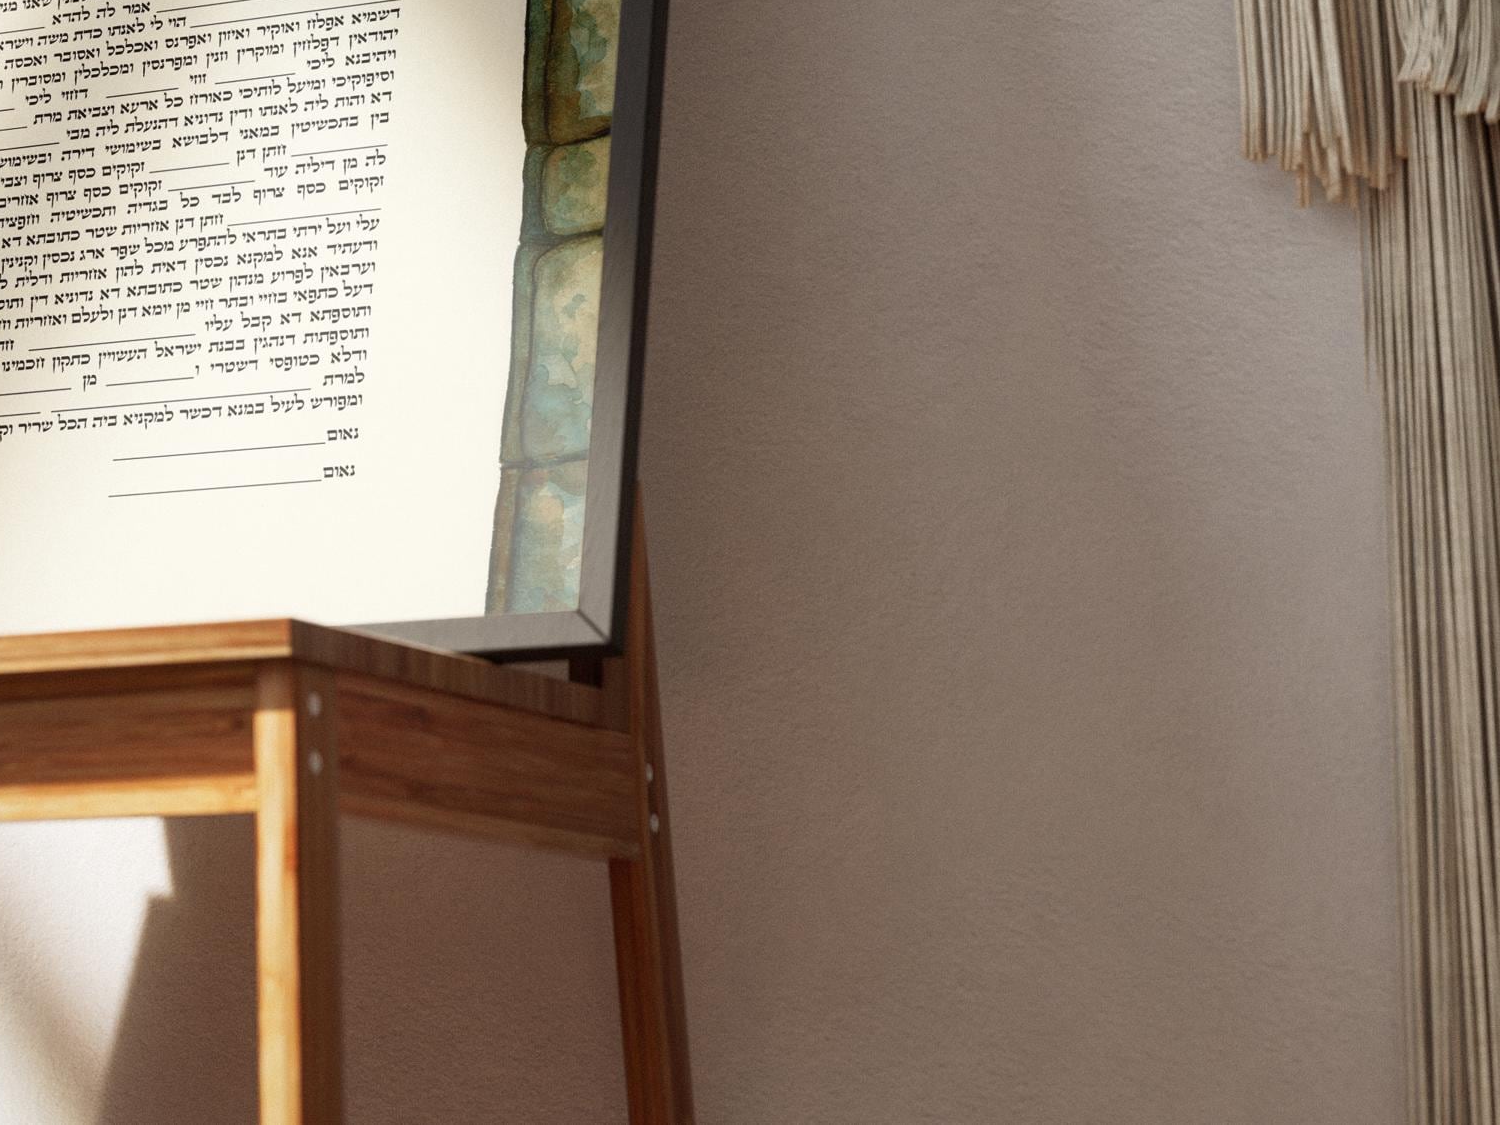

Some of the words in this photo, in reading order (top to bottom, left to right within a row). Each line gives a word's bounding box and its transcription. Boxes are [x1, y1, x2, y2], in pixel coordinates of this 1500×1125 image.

[107, 16, 146, 37] לאנתו
[149, 14, 164, 31] לי
[167, 16, 187, 28] הוי
[36, 32, 69, 47] משה
[72, 27, 103, 42] כדת
[348, 27, 399, 51] יהודאין
[236, 43, 285, 66] ומוקרין
[292, 32, 340, 58] דפלחין
[141, 54, 198, 78] ומפרנסין
[205, 50, 229, 70] וזנין
[306, 51, 336, 71] ליכי
[344, 48, 397, 67] ויהיבנא
[11, 71, 67, 94] ומסוברין
[73, 60, 135, 86] ומכלכלין
[189, 73, 207, 85] זוזי
[331, 69, 395, 92] וסיפוקיכי
[238, 78, 282, 100] לותיכי
[286, 76, 326, 94] ומיעל
[24, 87, 52, 107] ליכי
[60, 88, 89, 102] דחזי
[163, 91, 184, 109] כל
[189, 90, 233, 106] כאורח
[66, 104, 116, 121] וצביאת
[119, 98, 159, 115] ארעא
[32, 111, 63, 126] מרת
[290, 115, 359, 139] בתכשיטין
[370, 111, 390, 131] בין
[171, 126, 229, 149] דלבושא
[239, 124, 280, 140] במאני
[60, 146, 96, 162] דירה
[104, 138, 162, 156] בשימושי
[294, 155, 336, 175] דיליה
[342, 157, 358, 175] מן
[364, 148, 387, 167] לה
[263, 165, 289, 179] עוד
[45, 189, 77, 209] צרוף
[83, 185, 112, 204] כסף
[118, 179, 163, 200] זקוקים
[84, 225, 118, 239] שטר
[120, 219, 170, 236] אחריות
[174, 217, 195, 236] דנן
[199, 212, 224, 233] חתן
[0, 235, 23, 250] דא
[25, 229, 81, 247] כתובתא
[326, 239, 378, 255] ודעתיד
[236, 243, 284, 270] למקנא
[291, 245, 318, 260] אנא
[115, 258, 144, 284] להון
[150, 259, 187, 275] דאית
[194, 255, 229, 276] נכסין
[14, 269, 53, 289] ודלית
[59, 267, 108, 284] אחריות
[258, 291, 288, 304] בחיי
[292, 286, 339, 305] כתפאי
[341, 279, 374, 298] דעל
[141, 302, 173, 318] יומא
[175, 301, 191, 320] מן
[195, 298, 215, 311] חיי
[218, 295, 254, 309] ובתר
[14, 313, 68, 330] ואחריות
[70, 303, 114, 324] ולעלם
[117, 306, 138, 326] דנן
[207, 338, 246, 354] בבנת
[253, 333, 296, 355] דנהגין
[302, 327, 370, 346] ותוספתות
[98, 347, 148, 370] העשויין
[153, 340, 202, 358] ישראל
[1, 356, 46, 373] חכמינו
[51, 353, 91, 374] כתקון
[322, 365, 365, 387] למרת
[227, 402, 265, 417] במנא
[269, 392, 305, 414] לעיל
[310, 393, 363, 412] ומפורש
[91, 414, 118, 428] ביה
[122, 403, 175, 430] למקניא
[179, 405, 223, 420] דכשר
[17, 420, 54, 434] שריר
[56, 413, 88, 432] הכל
